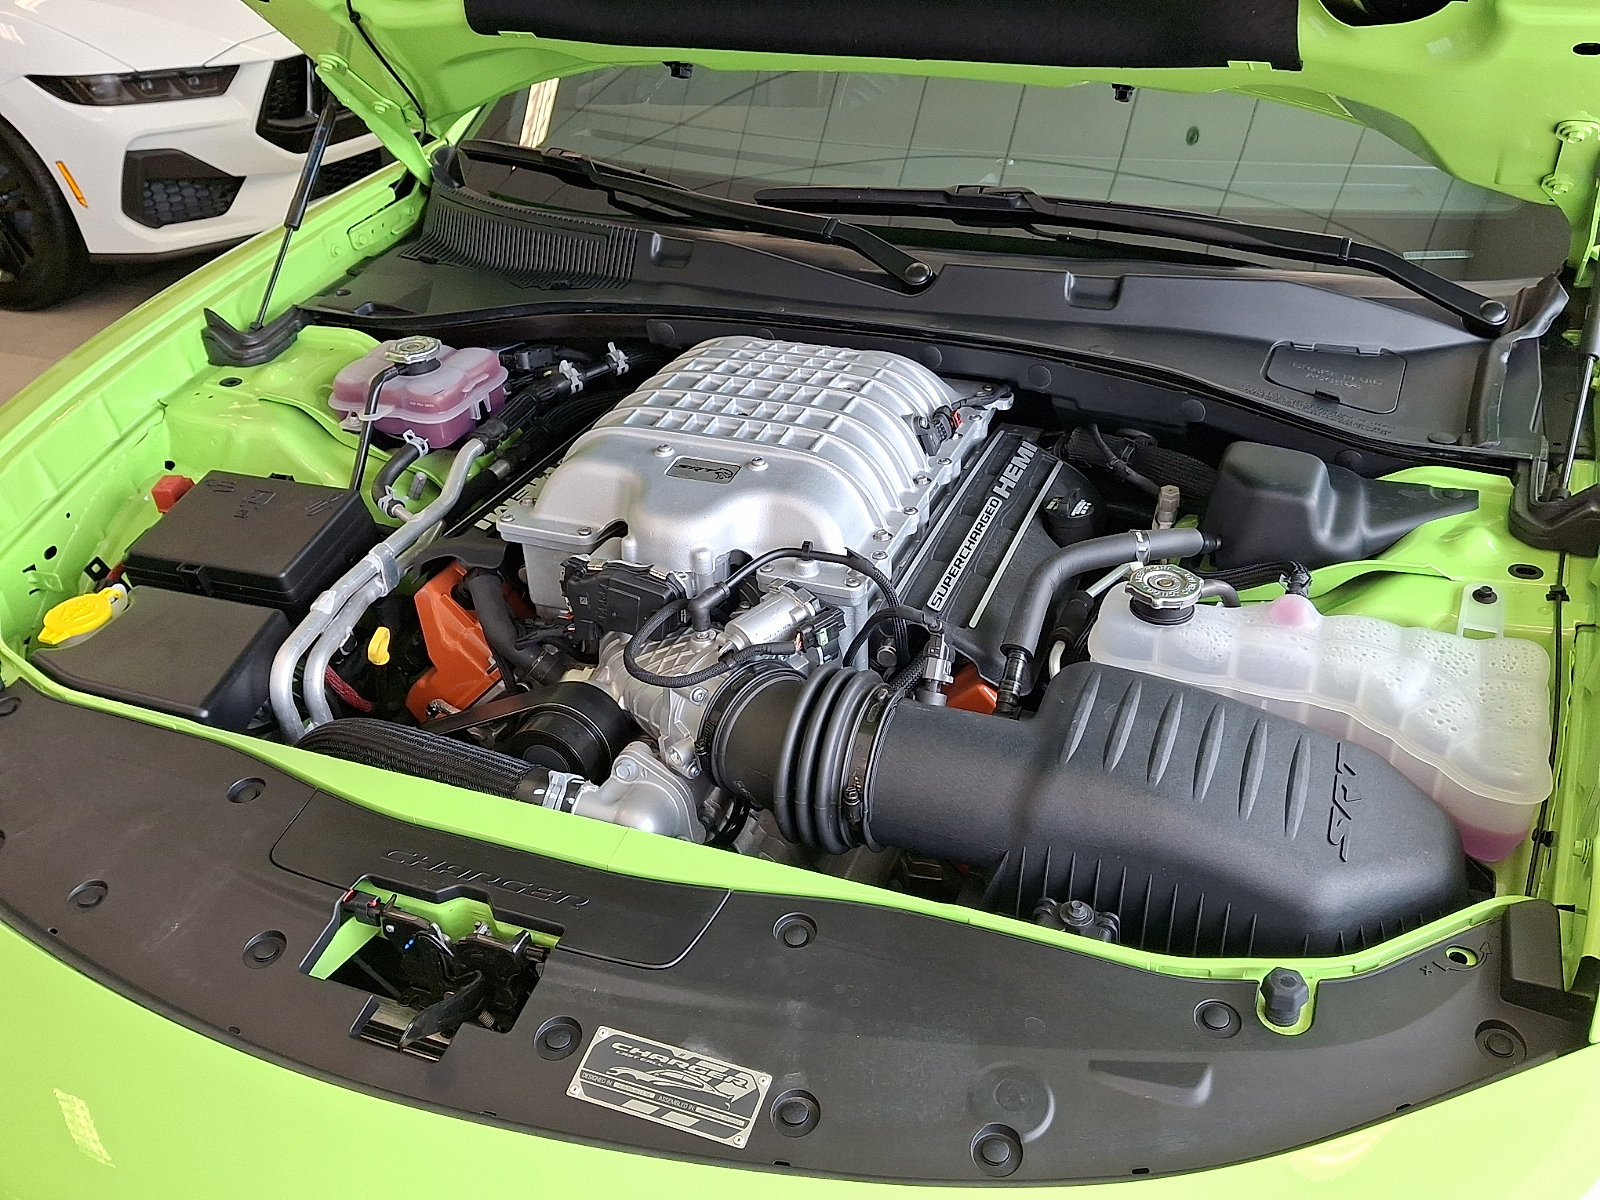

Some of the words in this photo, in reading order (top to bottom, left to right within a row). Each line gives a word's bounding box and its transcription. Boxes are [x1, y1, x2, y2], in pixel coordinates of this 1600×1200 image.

[930, 499, 1001, 609] SUPERCHARGED
[993, 440, 1038, 499] HEMI
[1326, 741, 1363, 863] SRT
[381, 850, 590, 909] CHARGER
[581, 1072, 607, 1085] DESIGNED
[611, 1042, 749, 1090] CHARGER
[639, 1057, 664, 1068] CALL
[657, 1095, 688, 1109] ASSEMBLED
